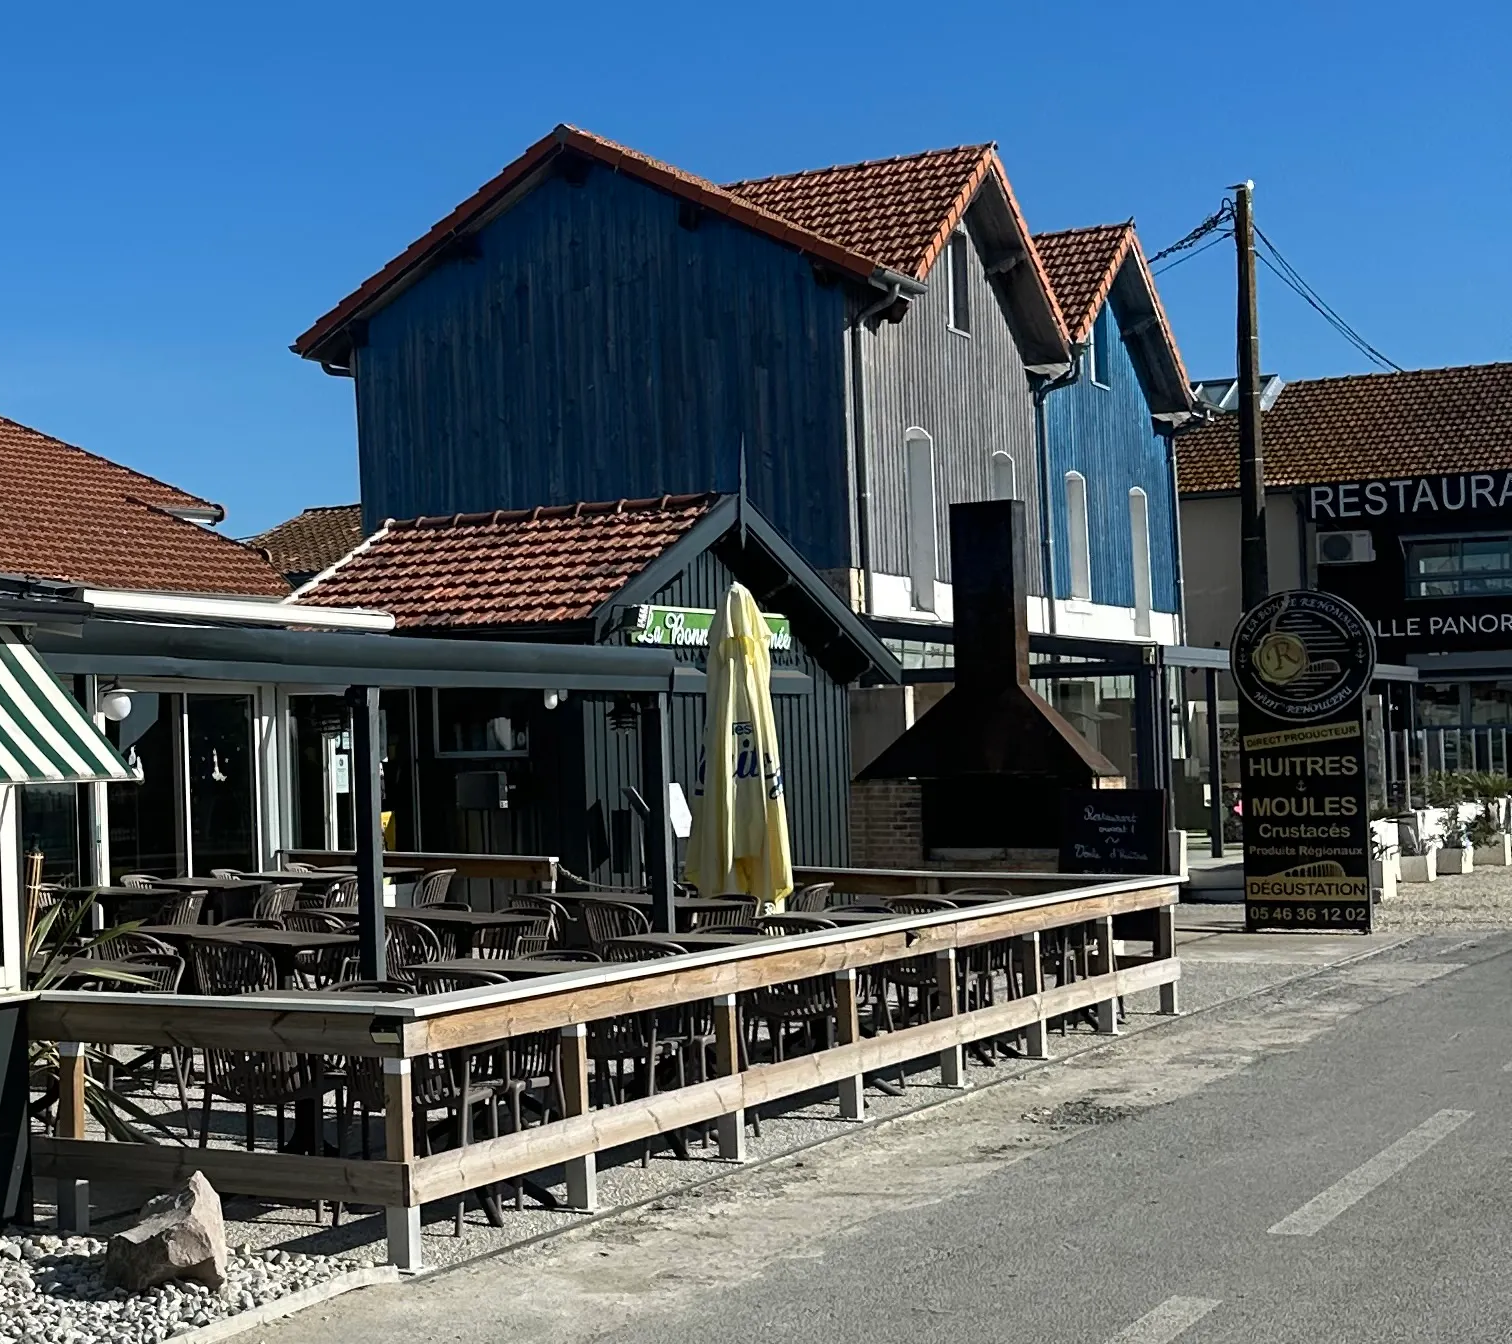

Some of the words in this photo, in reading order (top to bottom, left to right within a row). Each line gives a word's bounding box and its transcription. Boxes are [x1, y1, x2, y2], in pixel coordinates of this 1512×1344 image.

[665, 612, 709, 646] Bonn
[1247, 735, 1282, 748] DIRECT
[1284, 725, 1357, 742] PRODUCTEUR
[1249, 756, 1359, 777] HUITRES
[1252, 796, 1358, 817] MOULES
[1258, 822, 1351, 838] Crustacés
[1249, 845, 1297, 856] Produits
[1299, 845, 1363, 858] Régionaux
[1250, 879, 1366, 896] DÉGUSTATION
[1250, 906, 1269, 920] 05
[1272, 907, 1292, 920] 46
[1296, 907, 1316, 921] 36
[1321, 907, 1341, 921] 12
[1345, 907, 1367, 921] 02
